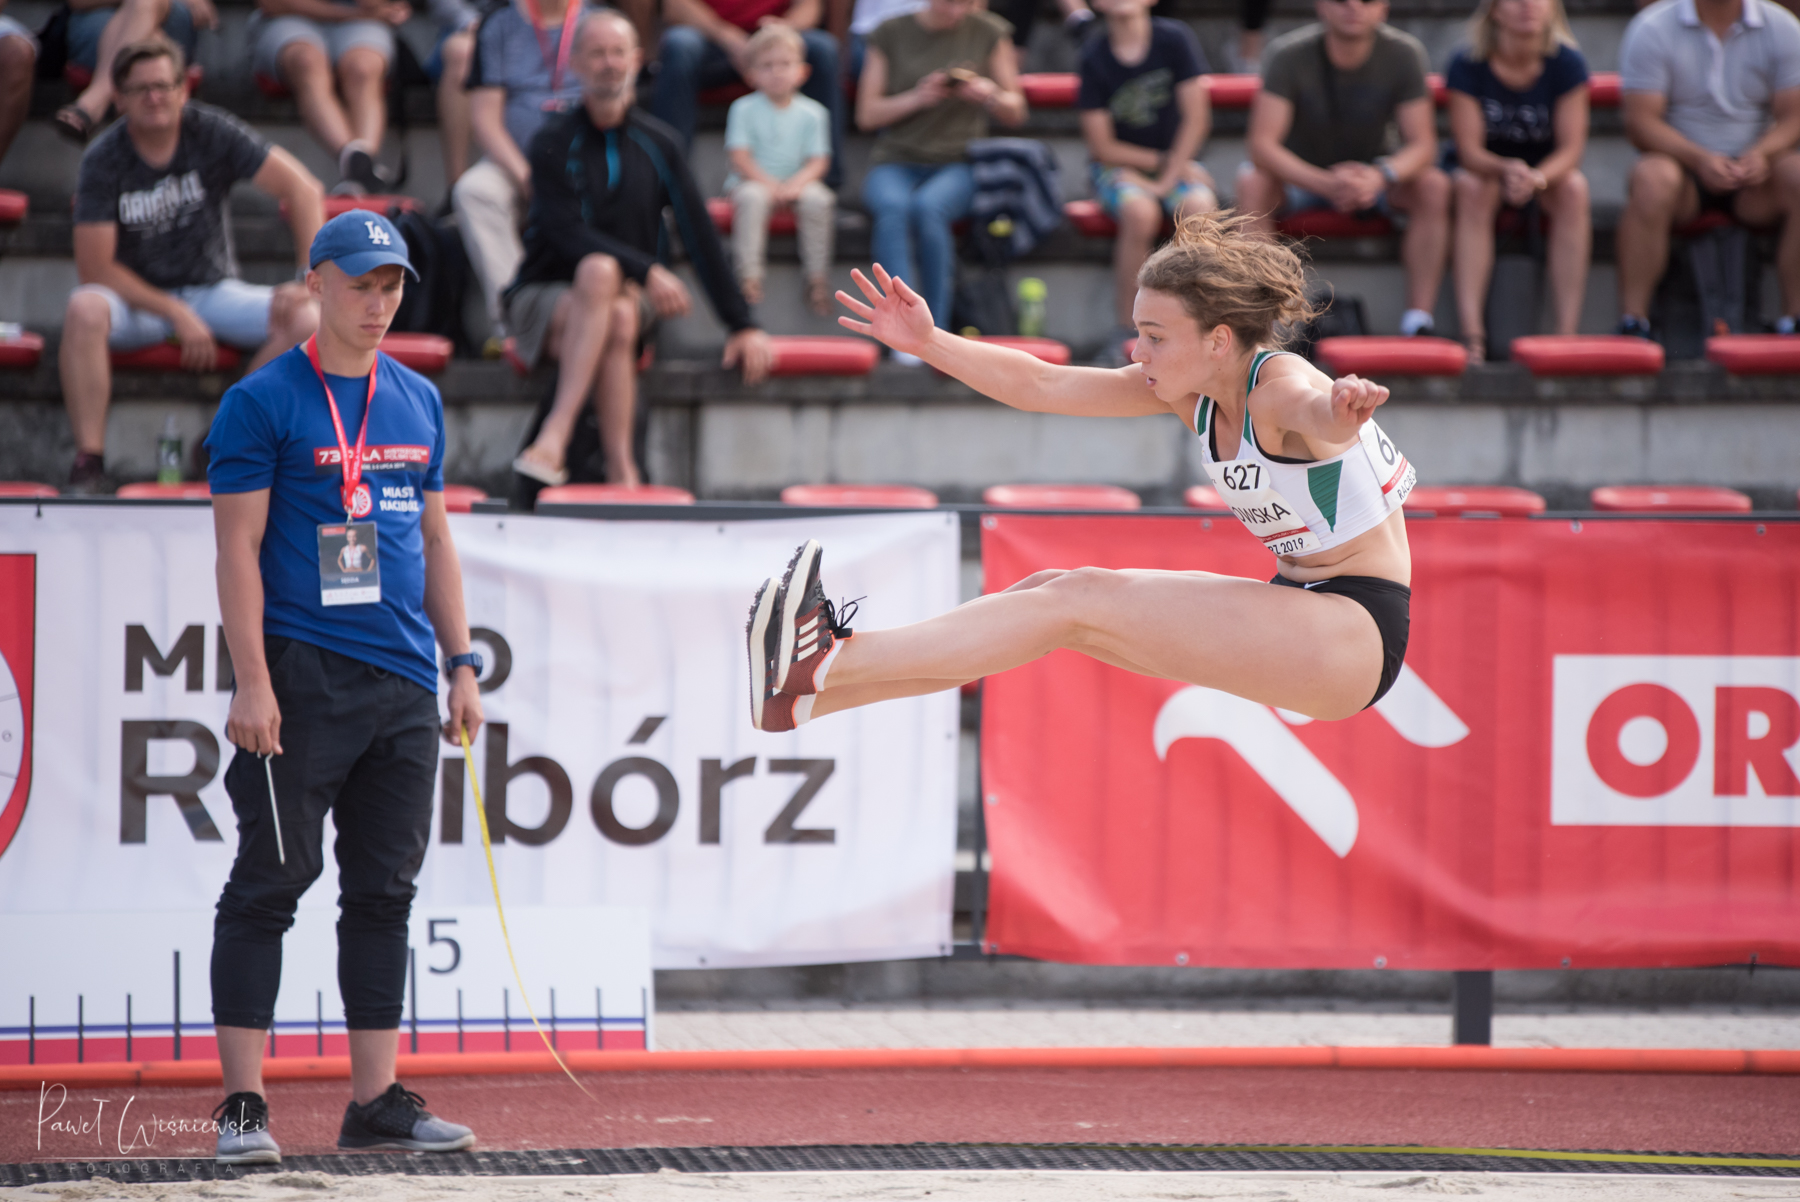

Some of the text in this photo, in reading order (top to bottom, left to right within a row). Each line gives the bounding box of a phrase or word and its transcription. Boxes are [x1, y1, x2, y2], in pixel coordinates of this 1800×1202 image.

[364, 221, 391, 246] LA
[1374, 425, 1399, 466] 6
[1223, 464, 1261, 491] 627
[1280, 537, 1304, 554] 2019
[118, 715, 837, 847] Ribórz
[426, 918, 462, 974] 5
